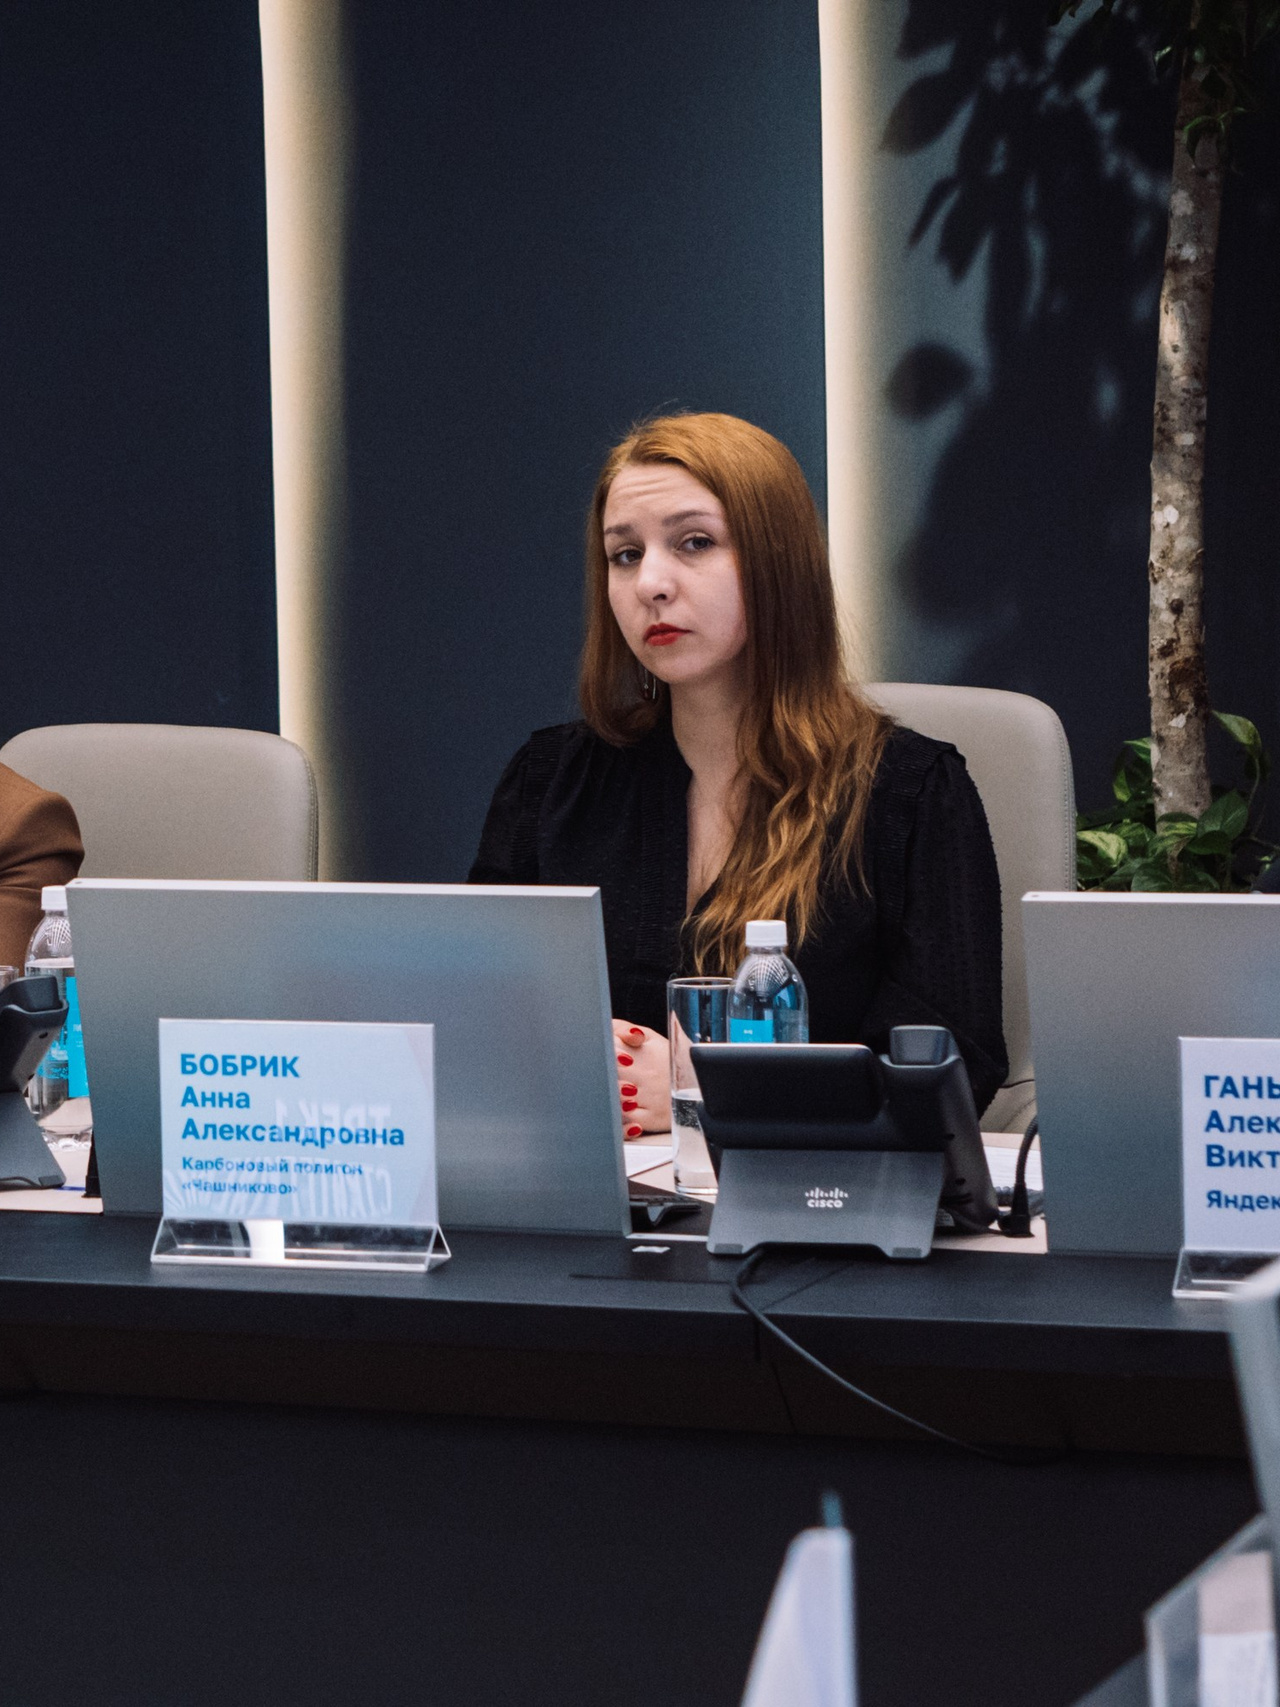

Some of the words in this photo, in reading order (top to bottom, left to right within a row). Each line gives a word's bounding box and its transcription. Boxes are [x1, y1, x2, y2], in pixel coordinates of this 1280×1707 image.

[180, 1053, 300, 1078] БОБРИК
[180, 1085, 251, 1109] Анна
[181, 1117, 405, 1149] Александровна
[1205, 1109, 1280, 1133] Алек
[182, 1156, 289, 1174] Карбоновый
[294, 1161, 363, 1175] полигон
[1206, 1144, 1280, 1168] Викт
[1207, 1190, 1280, 1212] Яндек
